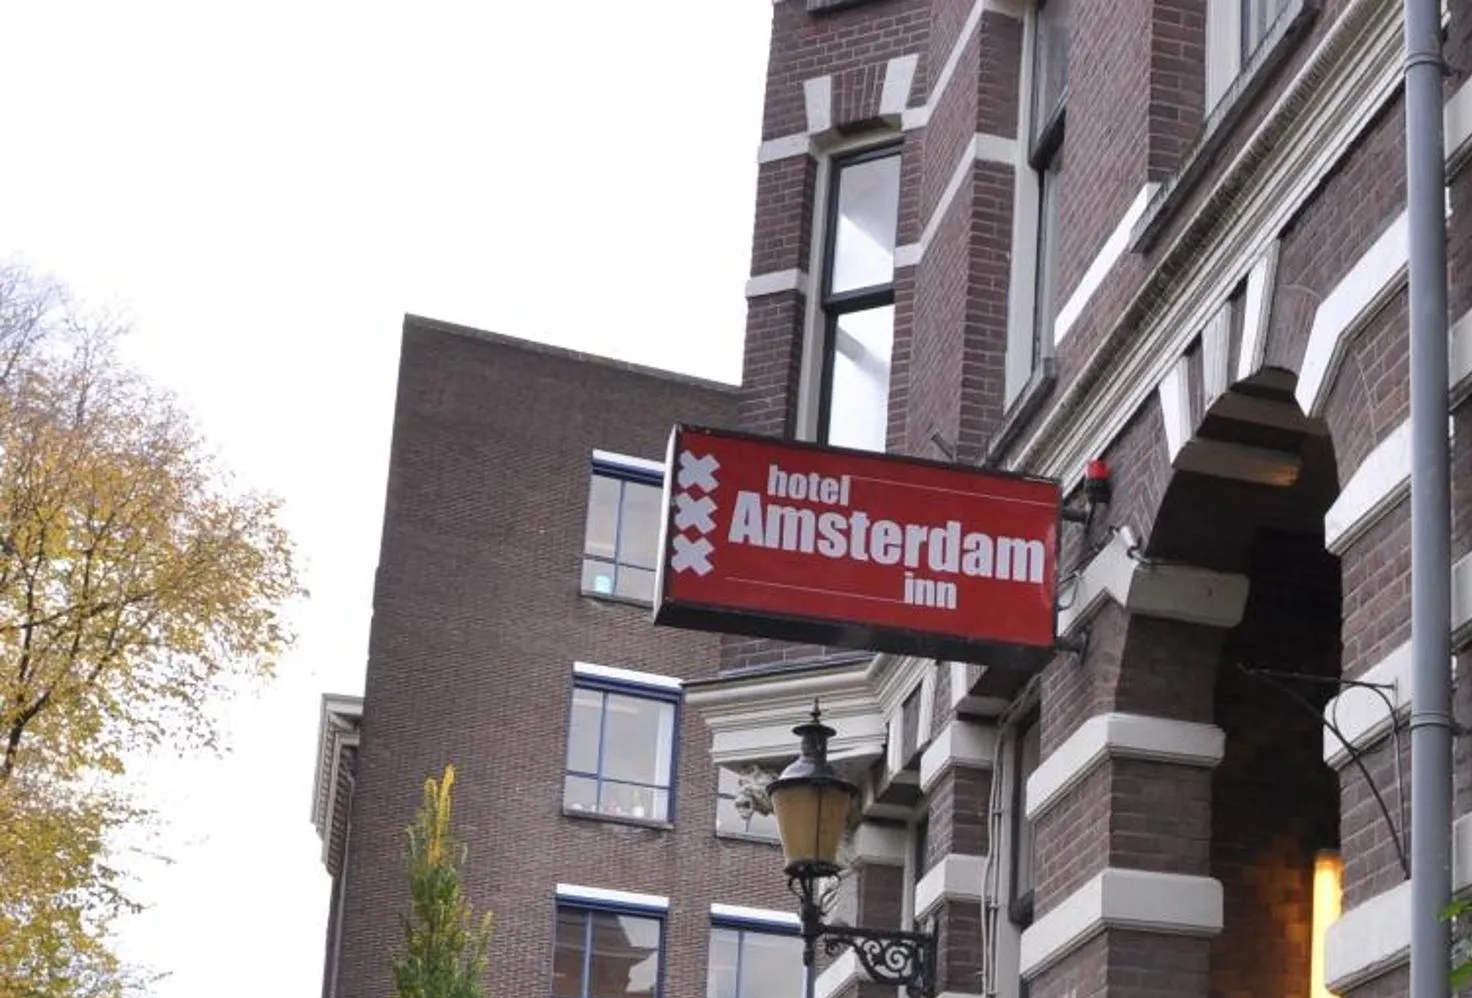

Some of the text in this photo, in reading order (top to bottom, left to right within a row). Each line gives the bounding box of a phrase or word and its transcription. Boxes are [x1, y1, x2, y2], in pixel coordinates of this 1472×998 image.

[768, 465, 851, 507] hotel
[728, 491, 1045, 584] Amsterdam
[904, 572, 957, 610] inn
